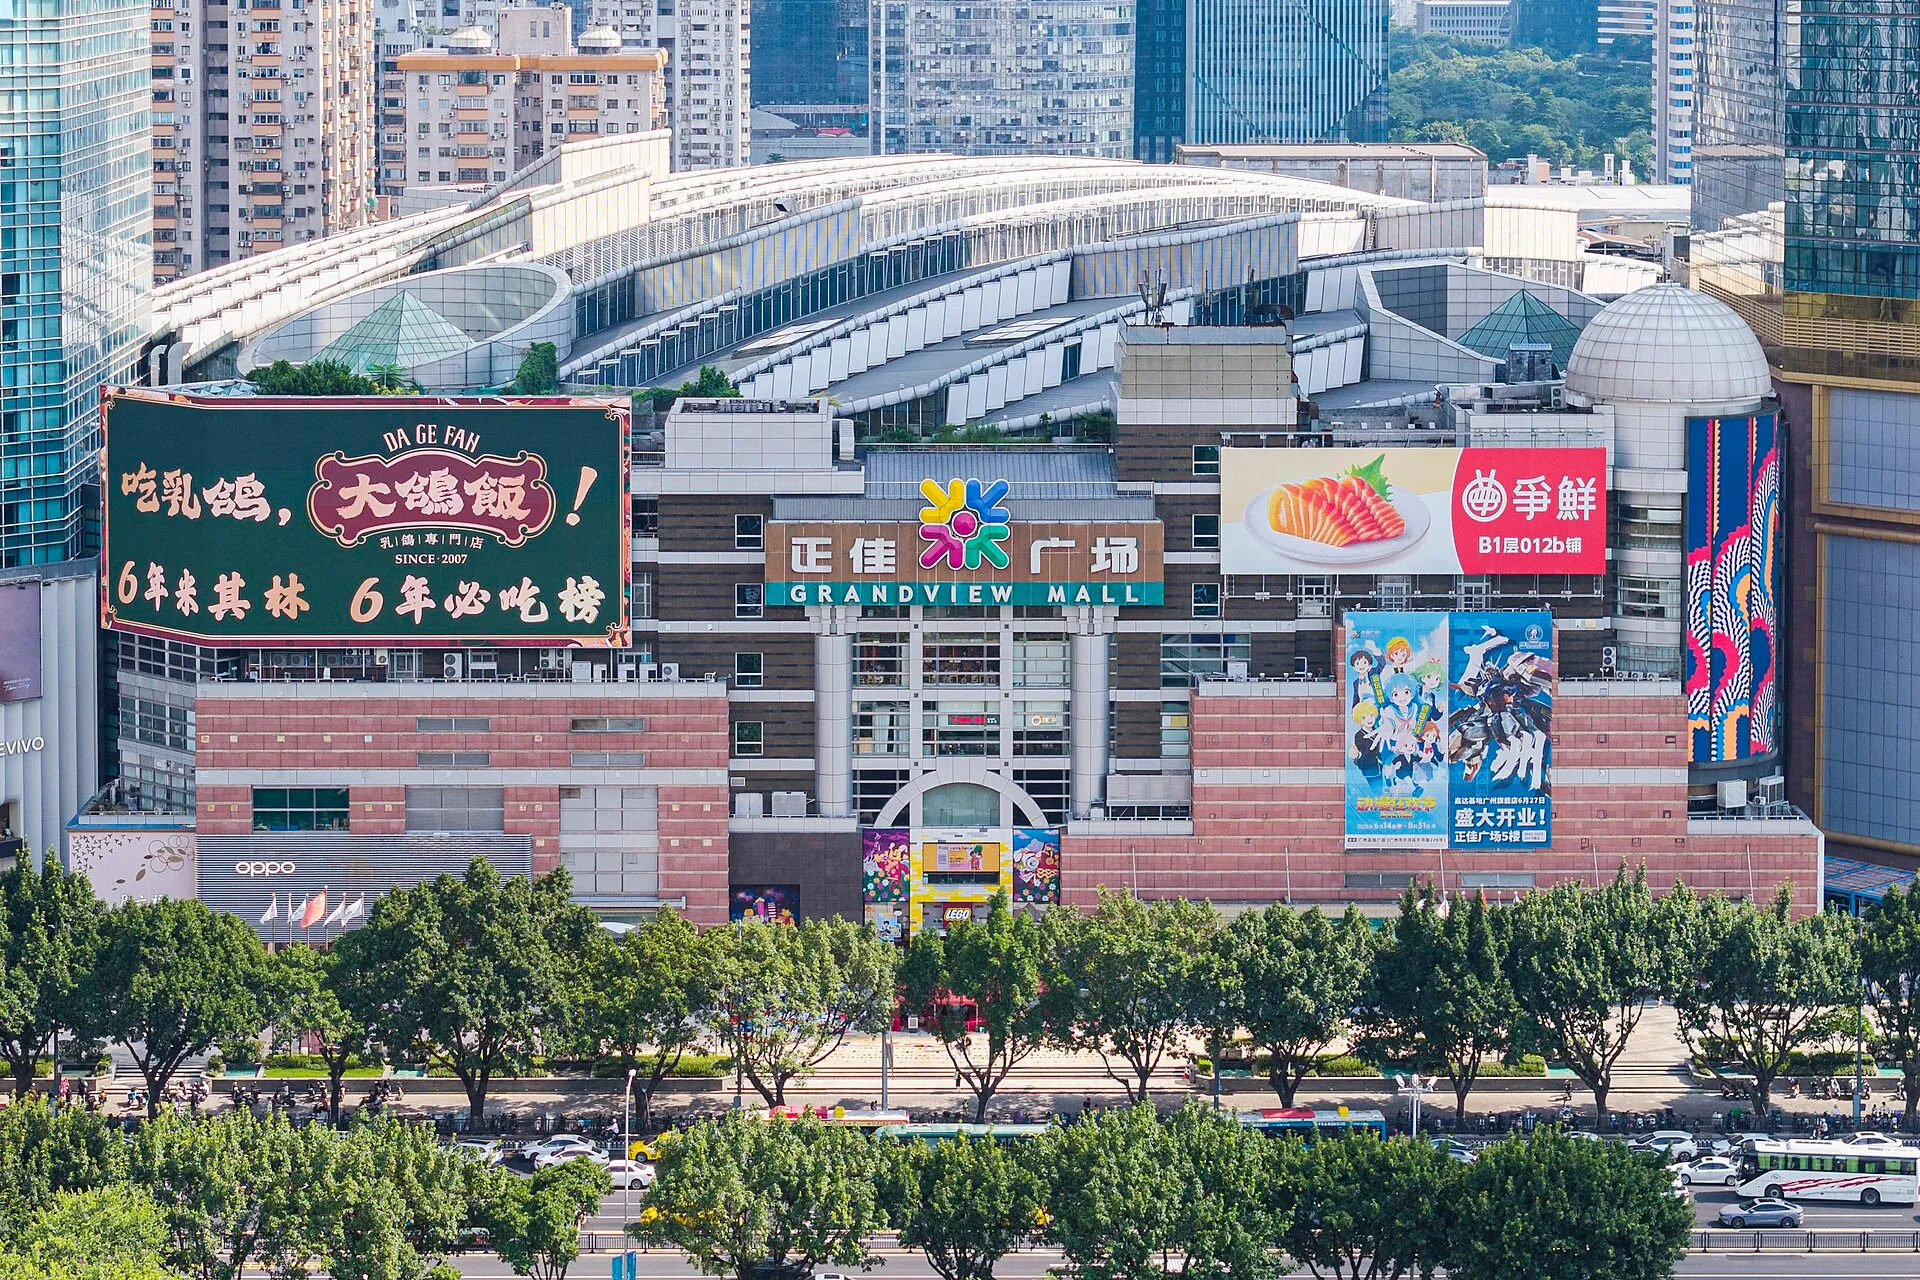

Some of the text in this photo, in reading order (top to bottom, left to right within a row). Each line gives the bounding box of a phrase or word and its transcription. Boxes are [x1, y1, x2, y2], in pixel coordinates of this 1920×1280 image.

[382, 424, 481, 453] DA GE FAN
[1478, 536, 1582, 554] B1层012b铺
[791, 537, 1139, 574] 正佳 广场
[118, 560, 606, 625] 6年米其林 6年必吃榜
[790, 585, 1139, 603] GRANDVIEW MALL
[1454, 830, 1521, 843] 正佳广场5楼
[945, 908, 970, 921] LEGO
